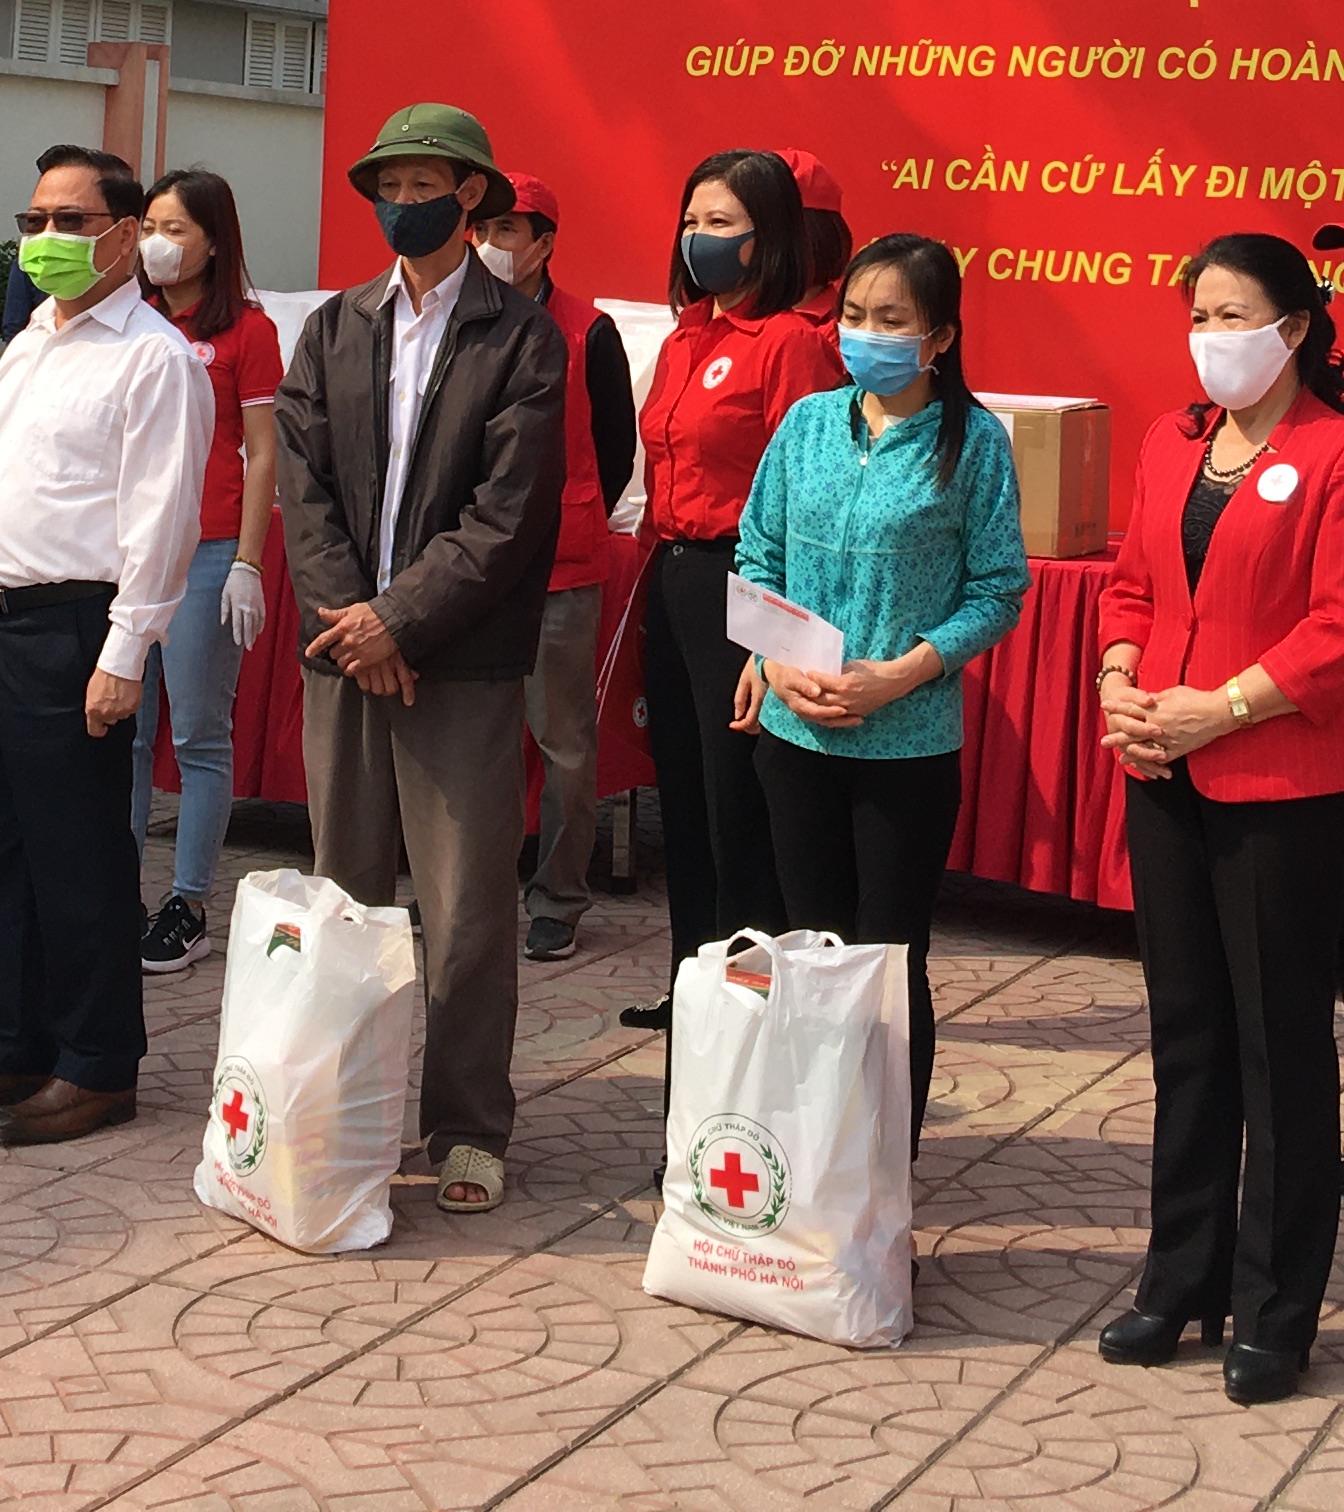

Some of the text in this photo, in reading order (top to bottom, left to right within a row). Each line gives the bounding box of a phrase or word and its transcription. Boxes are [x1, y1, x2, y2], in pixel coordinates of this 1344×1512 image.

[685, 37, 776, 78] GIÚP
[782, 38, 847, 78] ĐỠ
[851, 37, 997, 78] NHỮNG
[1006, 38, 1147, 80] NGƯỜI
[1156, 38, 1218, 81] CÓ
[944, 144, 1031, 193] CẦN
[1040, 153, 1106, 195] CỨ
[1111, 147, 1198, 197] LẤY
[1204, 164, 1249, 200] ĐI
[986, 246, 1134, 286] CHUNG
[1146, 252, 1198, 288] TA
[687, 1255, 805, 1293] THÀNH PHỐ HÀ NỘI
[693, 1238, 797, 1272] HỘI CHỮ THẬP ĐỎ
